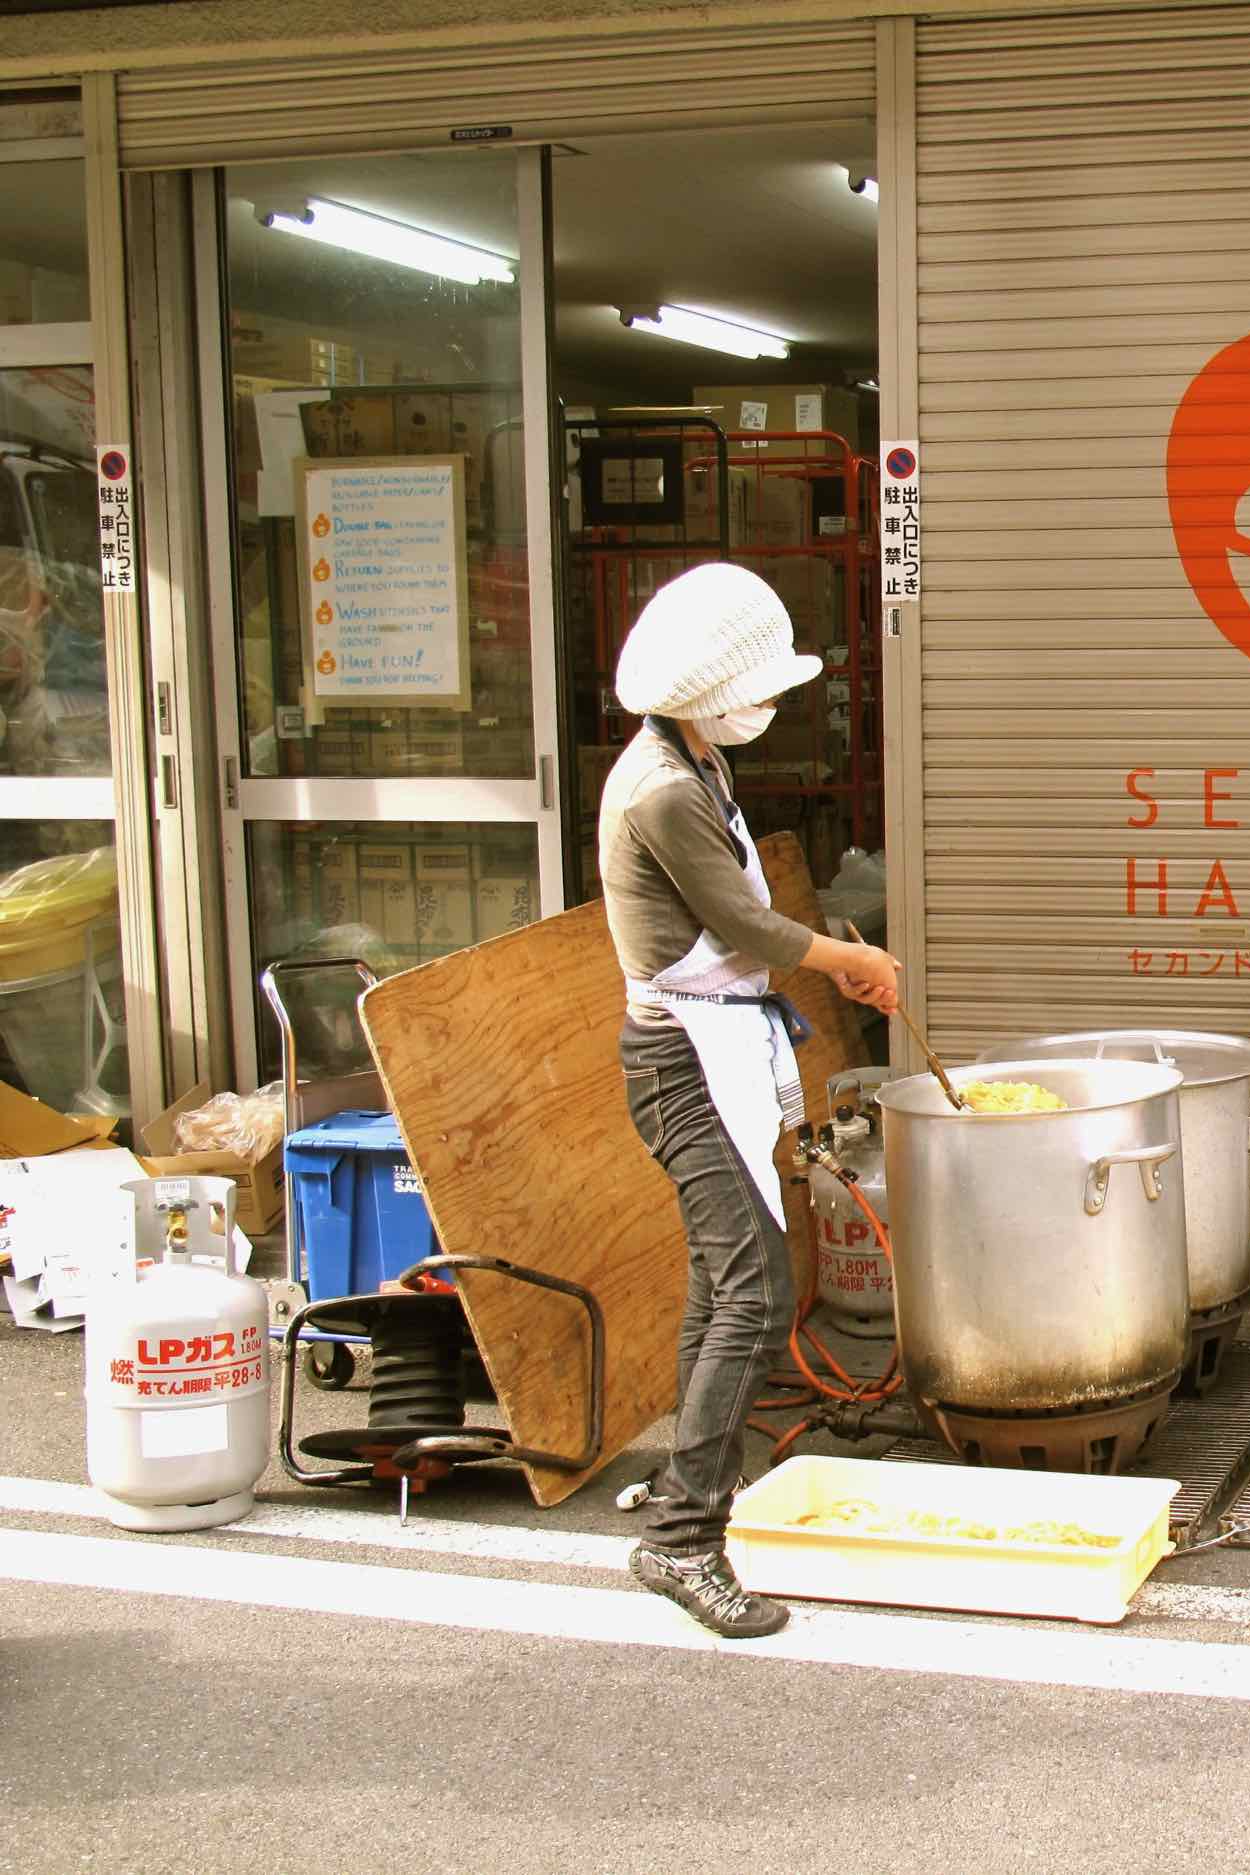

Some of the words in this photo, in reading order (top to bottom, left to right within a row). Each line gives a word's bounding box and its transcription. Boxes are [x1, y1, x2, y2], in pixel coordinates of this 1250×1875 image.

[100, 487, 116, 587] 駐車禁止
[115, 487, 131, 587] 出入口につき
[885, 487, 902, 595] 駐車禁止
[902, 487, 919, 595] 出入口につき
[836, 1258, 878, 1276] 1.80M
[137, 1333, 236, 1365] LPガス
[242, 1327, 257, 1340] FP
[110, 1357, 135, 1385] 燃
[137, 1377, 212, 1396] 充てん期限
